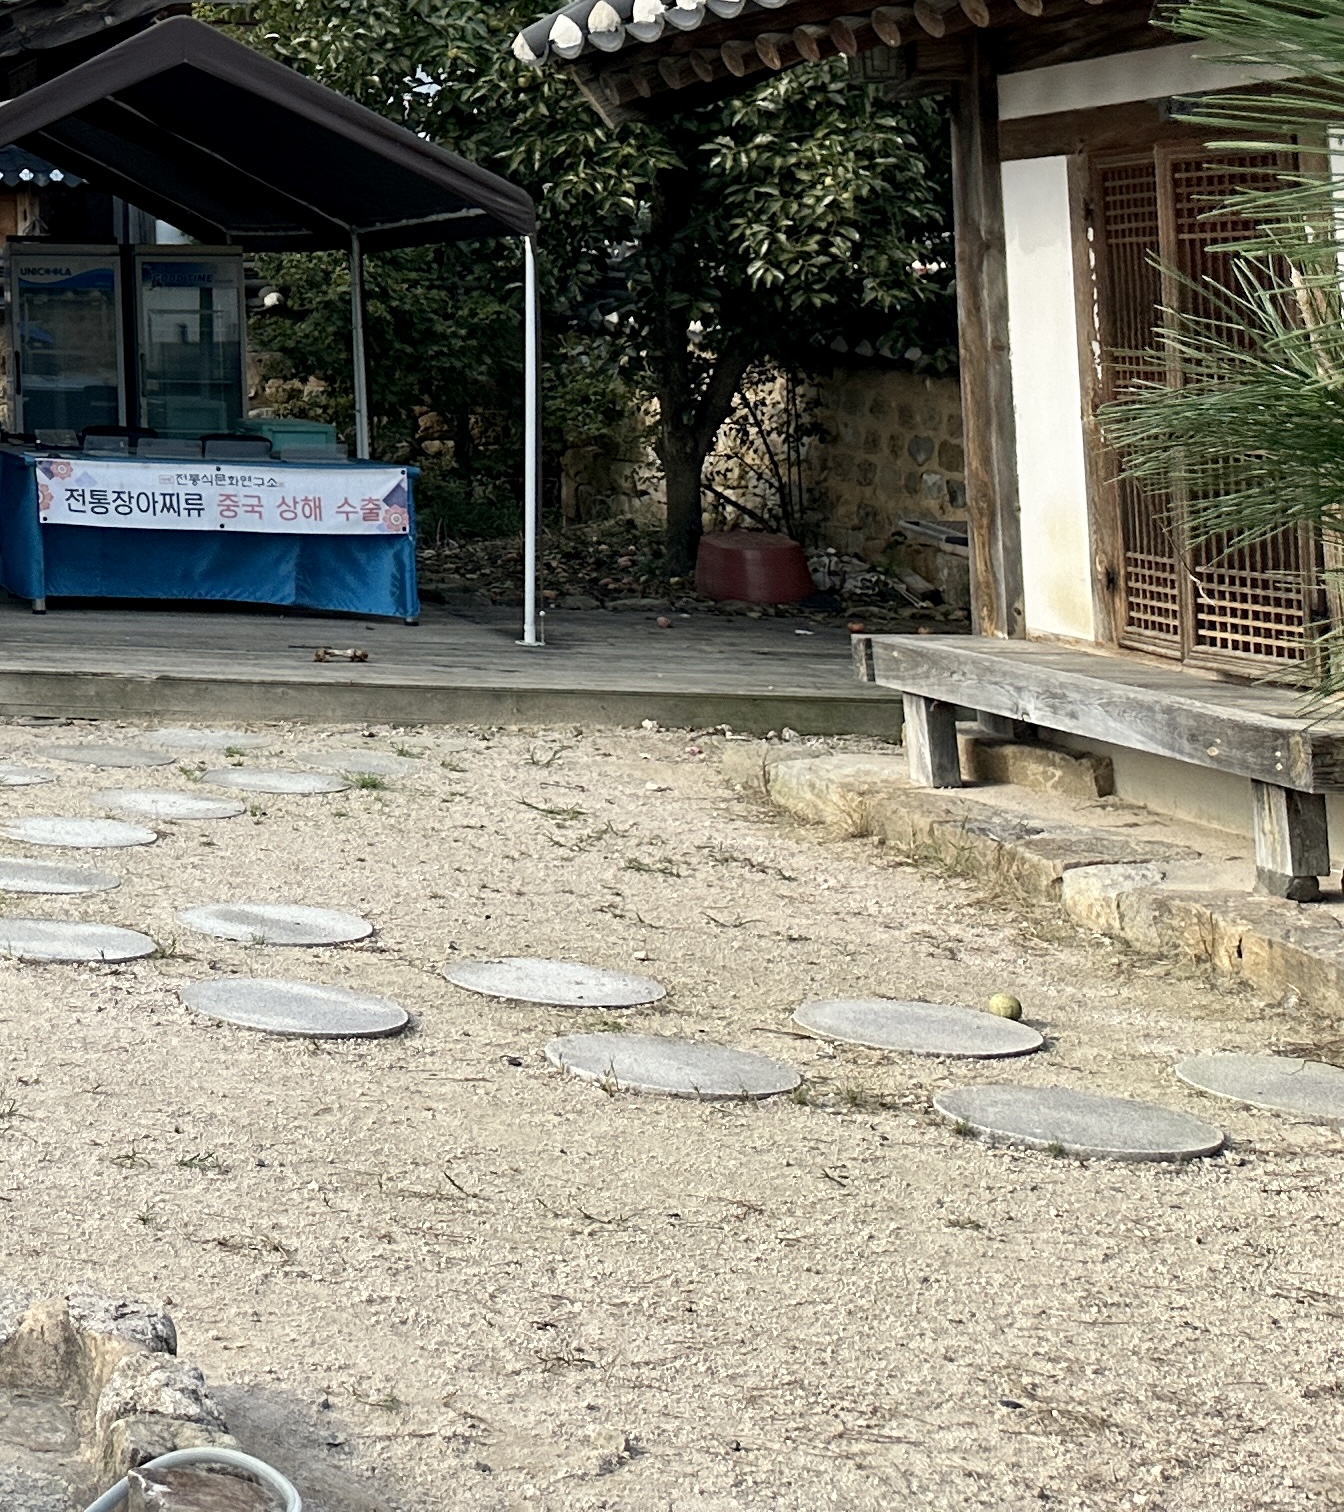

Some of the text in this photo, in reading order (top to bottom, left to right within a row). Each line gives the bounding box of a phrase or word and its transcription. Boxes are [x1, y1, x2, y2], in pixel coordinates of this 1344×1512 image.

[175, 473, 279, 488] 전통식문화연구소
[64, 488, 383, 522] 전통장아찌류 중국 상해 수출
